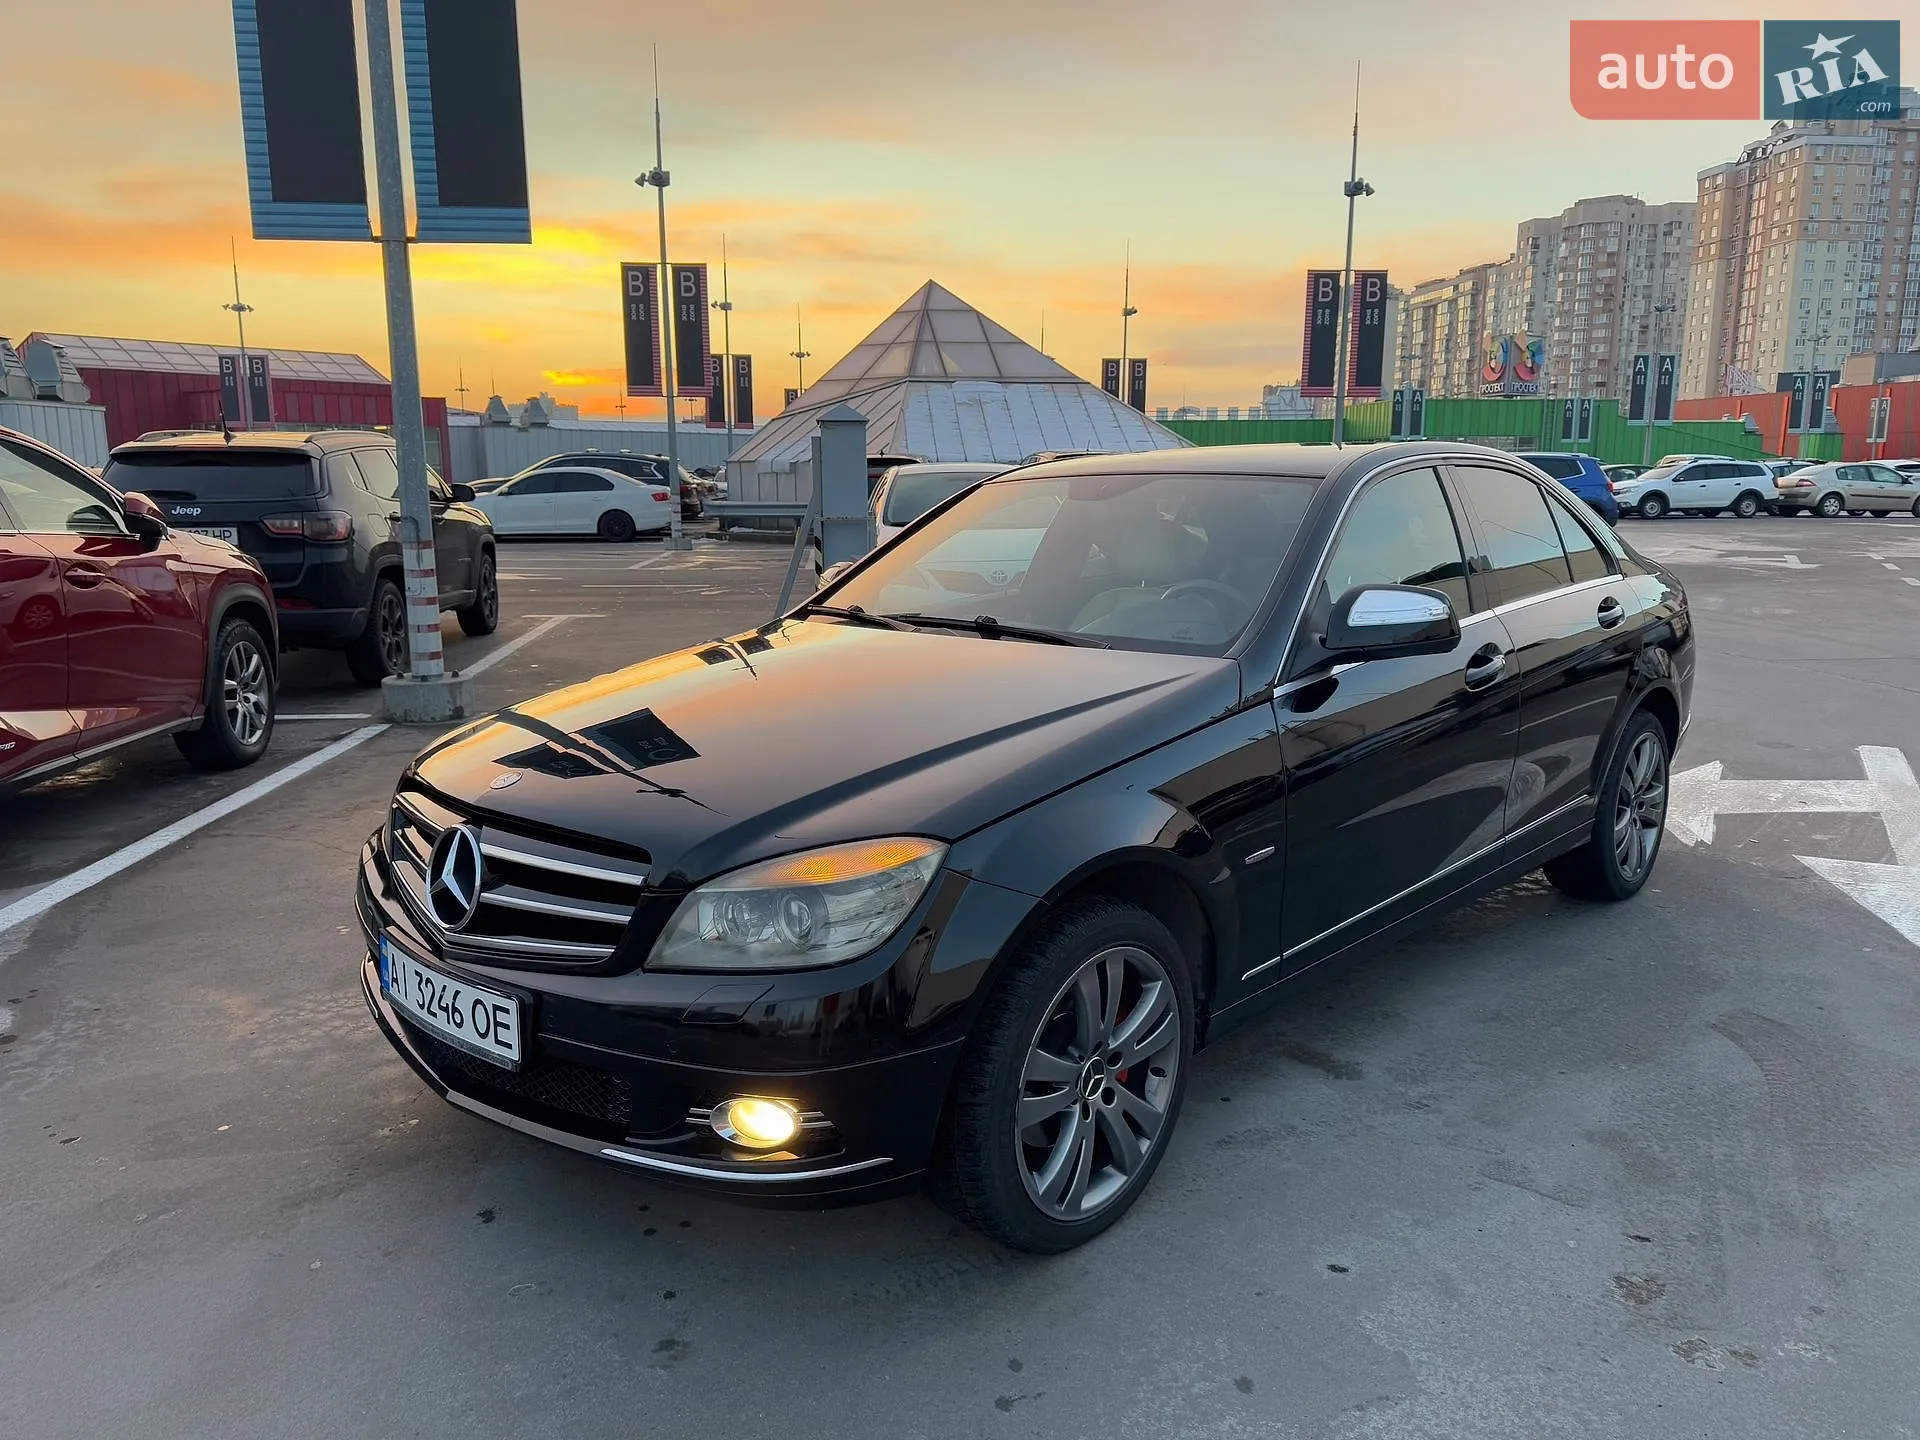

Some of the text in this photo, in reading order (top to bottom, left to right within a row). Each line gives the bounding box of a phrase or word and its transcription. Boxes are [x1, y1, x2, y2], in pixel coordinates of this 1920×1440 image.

[628, 271, 644, 297] B
[680, 271, 696, 297] B
[1318, 278, 1333, 302] B
[1366, 278, 1380, 302] B
[222, 358, 233, 373] B
[252, 359, 263, 374] B
[739, 359, 748, 374] B
[1108, 362, 1118, 377] B
[1135, 362, 1144, 377] B
[1635, 357, 1645, 372] A
[1662, 357, 1672, 372] A
[1794, 378, 1803, 390] A
[1815, 378, 1824, 390] A
[171, 505, 202, 516] Jeep
[391, 953, 408, 1000] AI
[414, 969, 464, 1029] 3246
[471, 998, 513, 1050] OE
